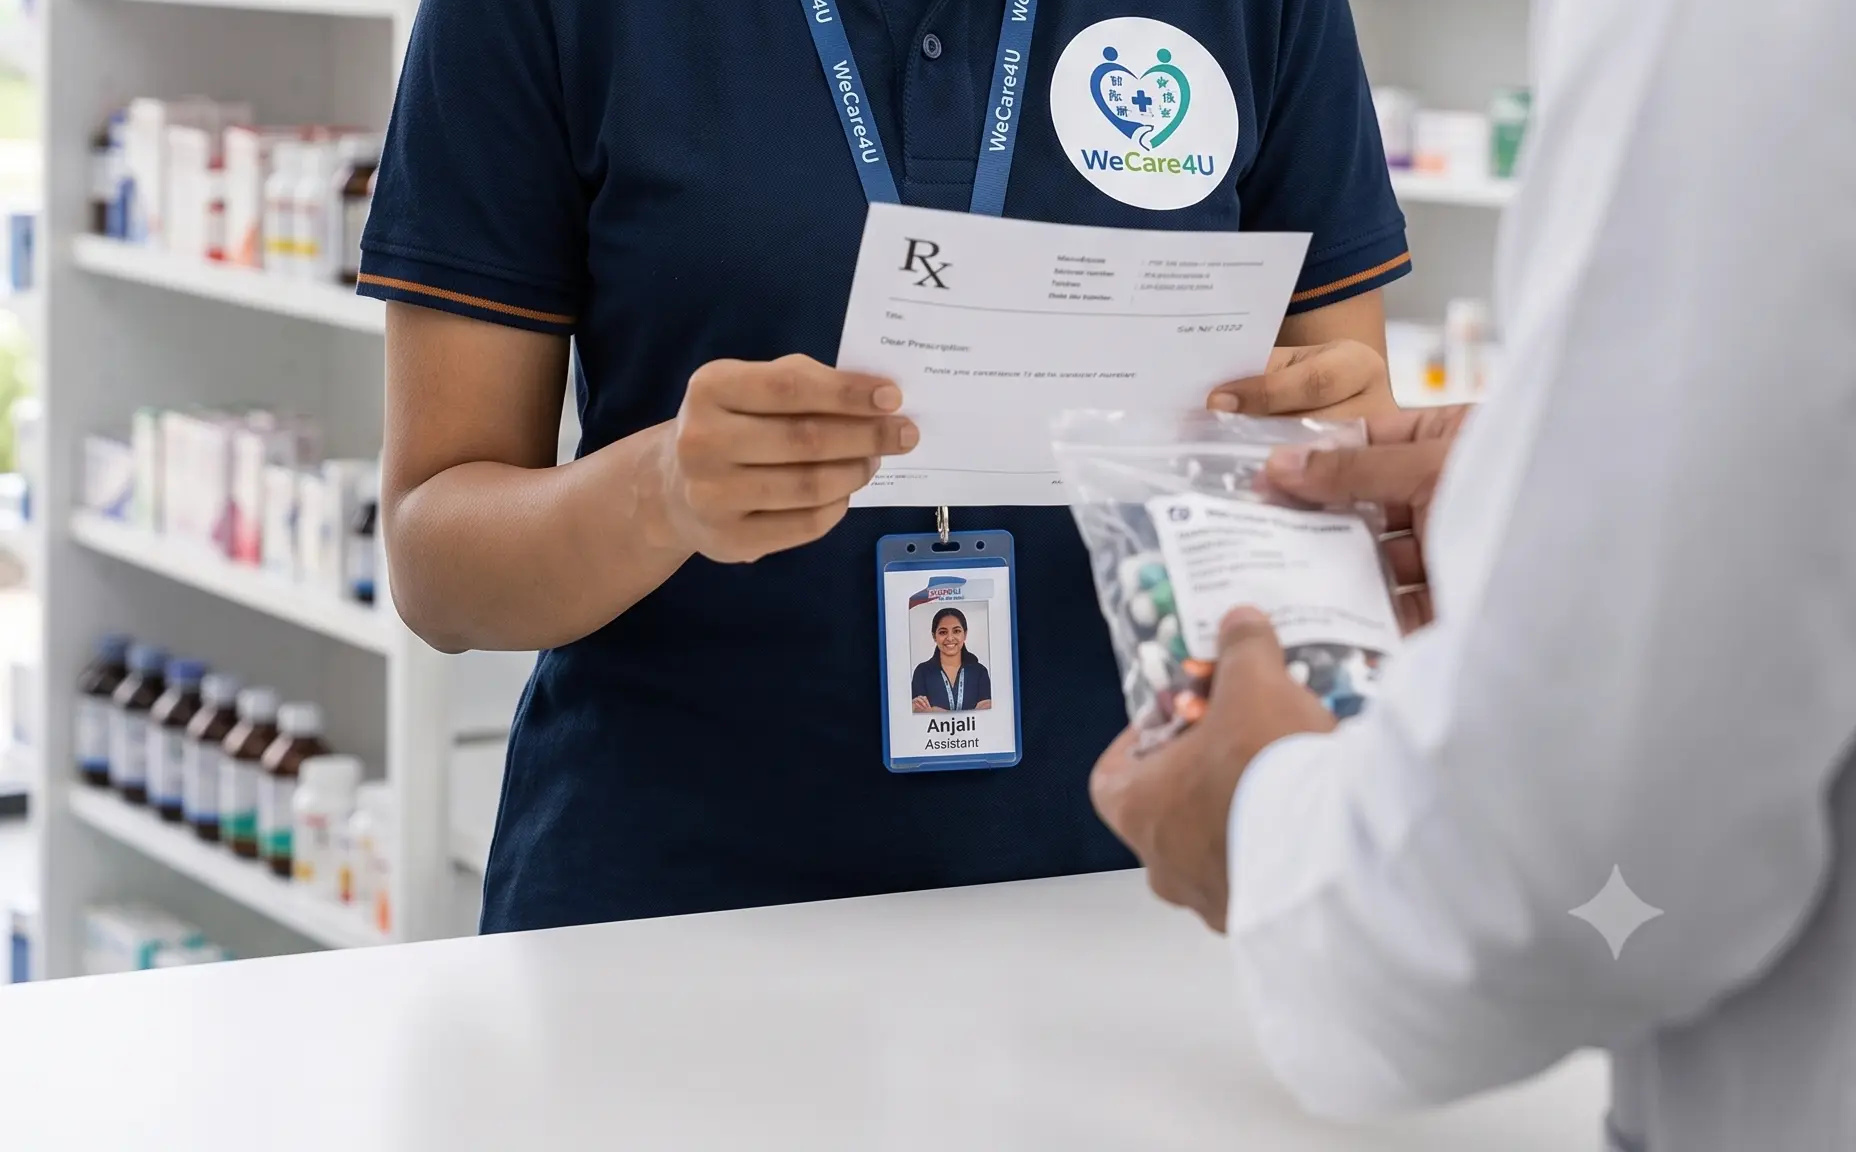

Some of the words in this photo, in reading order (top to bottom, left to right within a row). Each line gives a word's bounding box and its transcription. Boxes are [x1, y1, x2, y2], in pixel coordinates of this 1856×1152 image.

[833, 60, 880, 164] WeCare4U
[989, 49, 1021, 152] WeCare4U
[1081, 149, 1214, 176] WeCare4U
[927, 716, 976, 735] Anjali
[925, 737, 980, 751] Assistant
